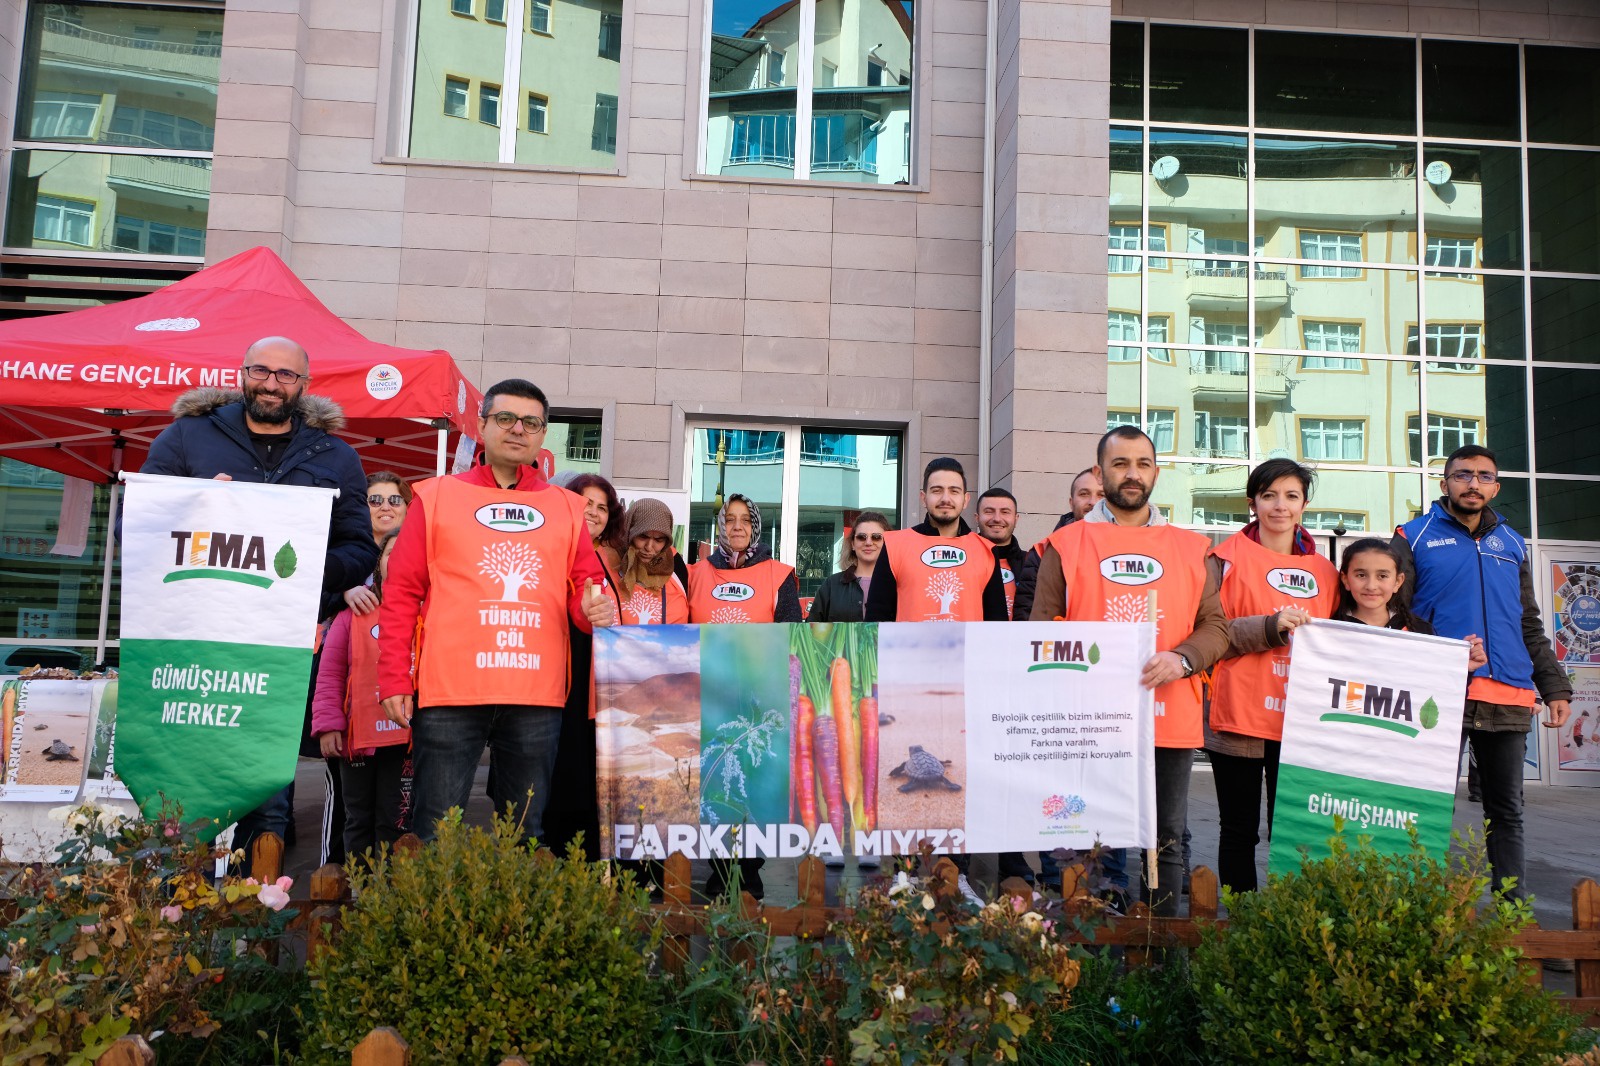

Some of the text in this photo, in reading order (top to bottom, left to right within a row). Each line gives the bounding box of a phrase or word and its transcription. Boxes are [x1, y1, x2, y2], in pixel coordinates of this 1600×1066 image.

[80, 362, 193, 388] GENÇLİK
[490, 508, 526, 521] TEMA
[171, 531, 266, 571] TEMA
[931, 550, 958, 560] TEMA
[1112, 560, 1145, 572] TEMA
[720, 585, 741, 594] TEMA
[1279, 572, 1306, 588] TEMA
[478, 605, 540, 628] TÜRKİYE
[496, 628, 525, 650] ÇÖL
[476, 652, 540, 670] OLMASIN
[1030, 640, 1084, 662] TEMA
[152, 664, 270, 697] GÜMÜŞHANE
[1328, 678, 1412, 722] TEMA
[162, 702, 242, 727] MERKEZ
[992, 714, 1028, 722] Biyolojik
[1032, 713, 1066, 722] çeşitlilik
[1094, 712, 1133, 720] iklimimiz,
[1006, 725, 1122, 735] şifamız, gıdamız, mirasımız.
[1066, 739, 1098, 747] varalım,
[994, 750, 1133, 762] biyolojik çeşitliliğimizi koruyalım.
[1308, 792, 1419, 830] GÜMÜŞHANE
[614, 823, 965, 860] FARKINDA MIYIZ?
